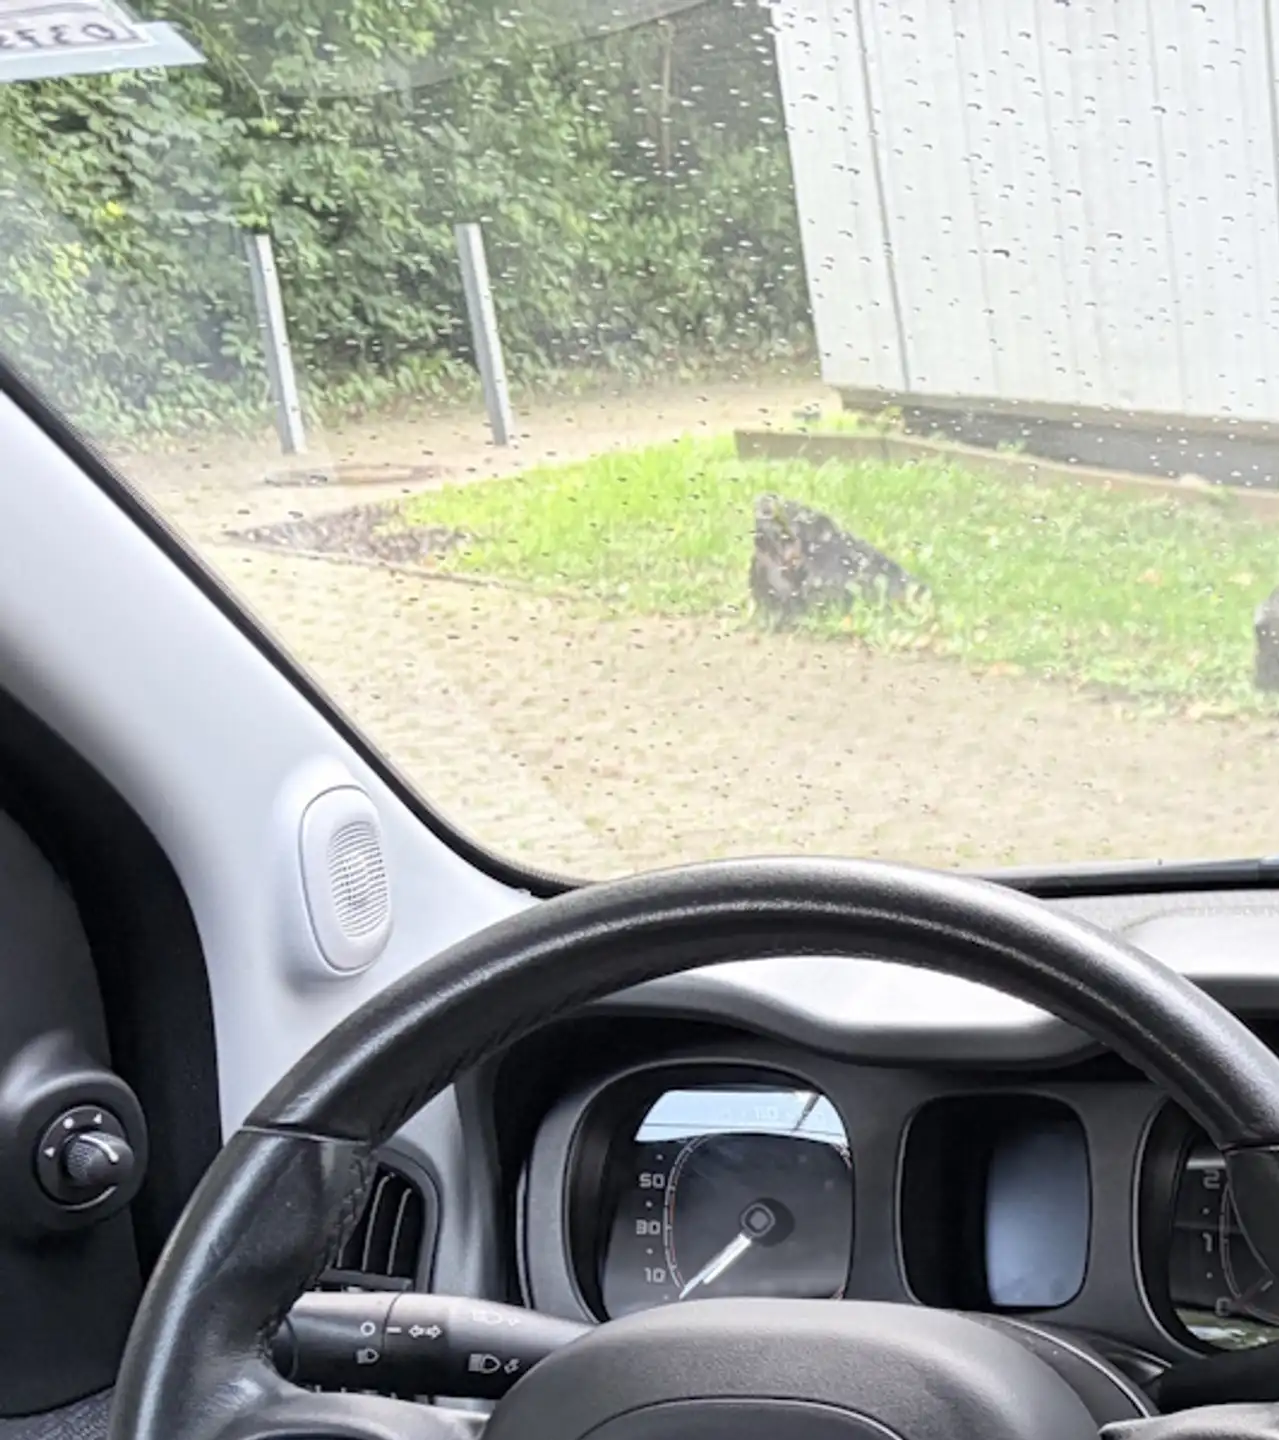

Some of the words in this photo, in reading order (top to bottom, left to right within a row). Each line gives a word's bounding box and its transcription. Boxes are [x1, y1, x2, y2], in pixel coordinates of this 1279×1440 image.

[639, 1174, 665, 1188] 50
[1203, 1170, 1220, 1189] 2
[636, 1219, 661, 1235] 30
[1203, 1233, 1213, 1252] 1
[644, 1267, 666, 1283] 10
